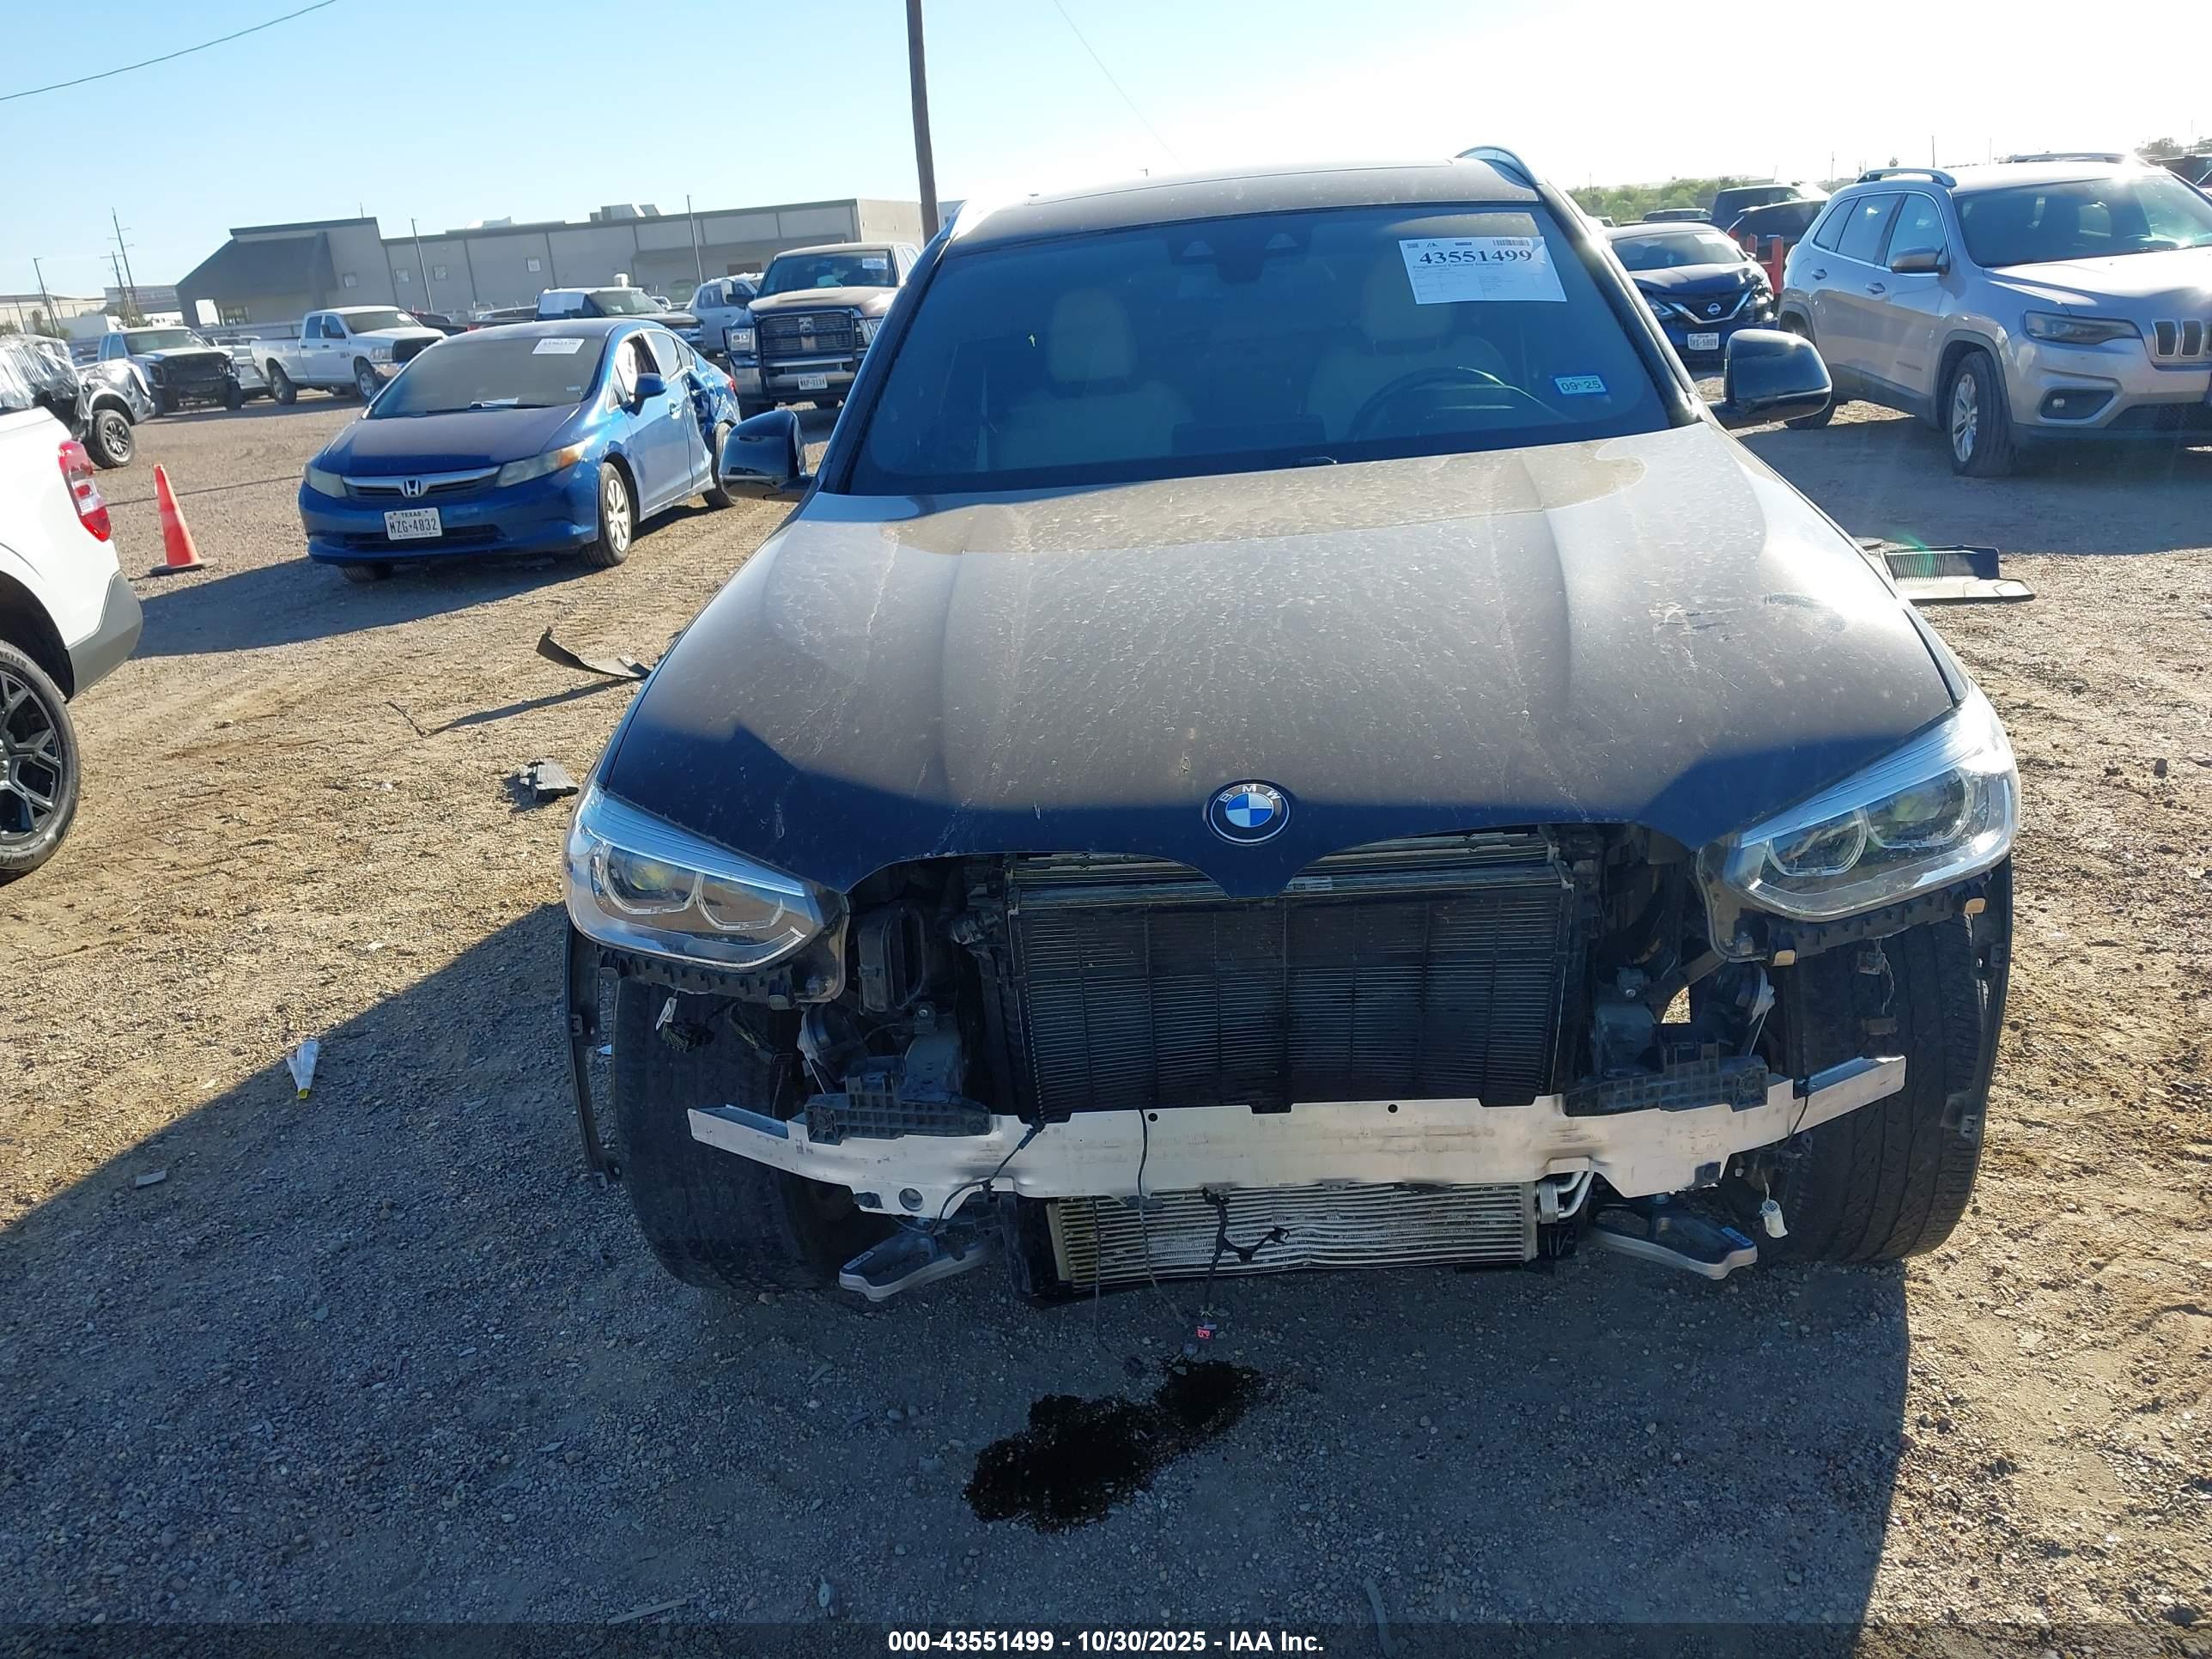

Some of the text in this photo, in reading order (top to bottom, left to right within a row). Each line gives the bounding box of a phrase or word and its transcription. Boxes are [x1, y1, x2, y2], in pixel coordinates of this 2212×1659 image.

[1419, 249, 1533, 264] 43551499
[1560, 380, 1601, 392] 09 25
[1218, 783, 1282, 803] BMW
